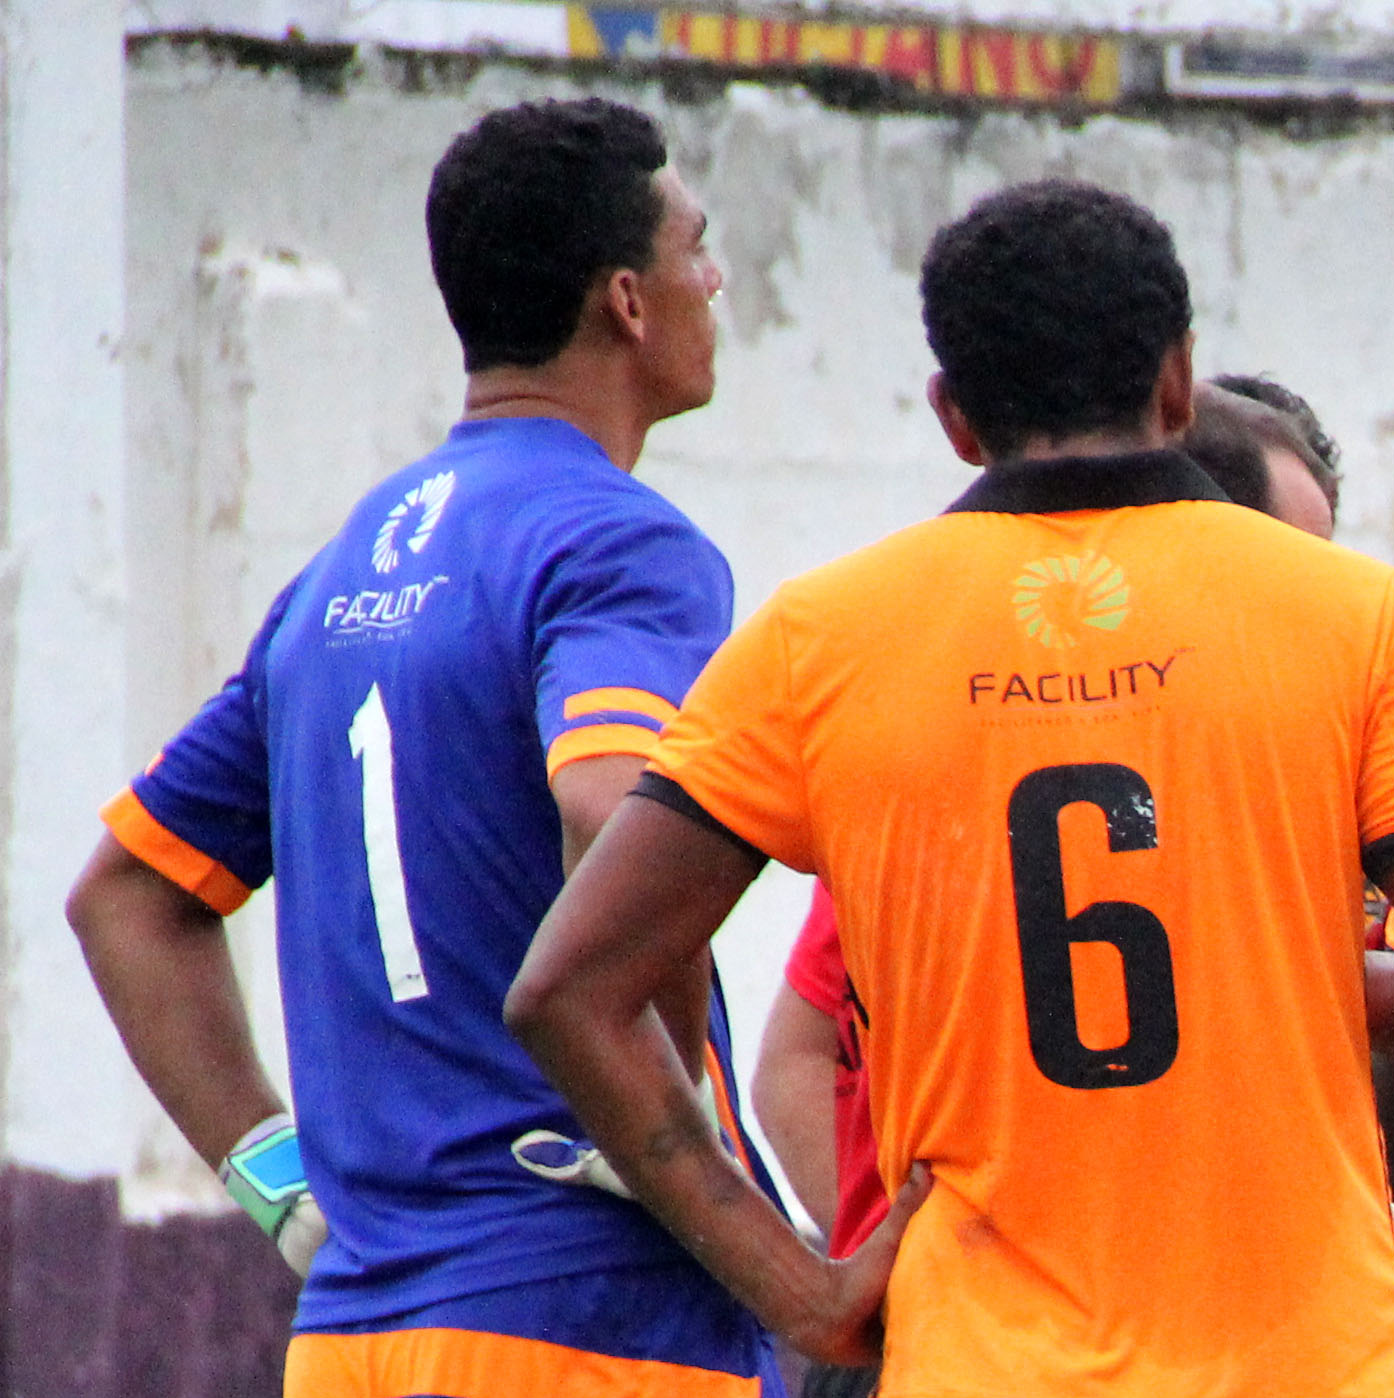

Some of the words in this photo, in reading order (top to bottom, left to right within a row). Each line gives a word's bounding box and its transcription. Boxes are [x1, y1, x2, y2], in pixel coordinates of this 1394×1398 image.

[969, 656, 1175, 704] FACILITY
[348, 681, 429, 1002] 1
[1007, 762, 1179, 1090] 6
